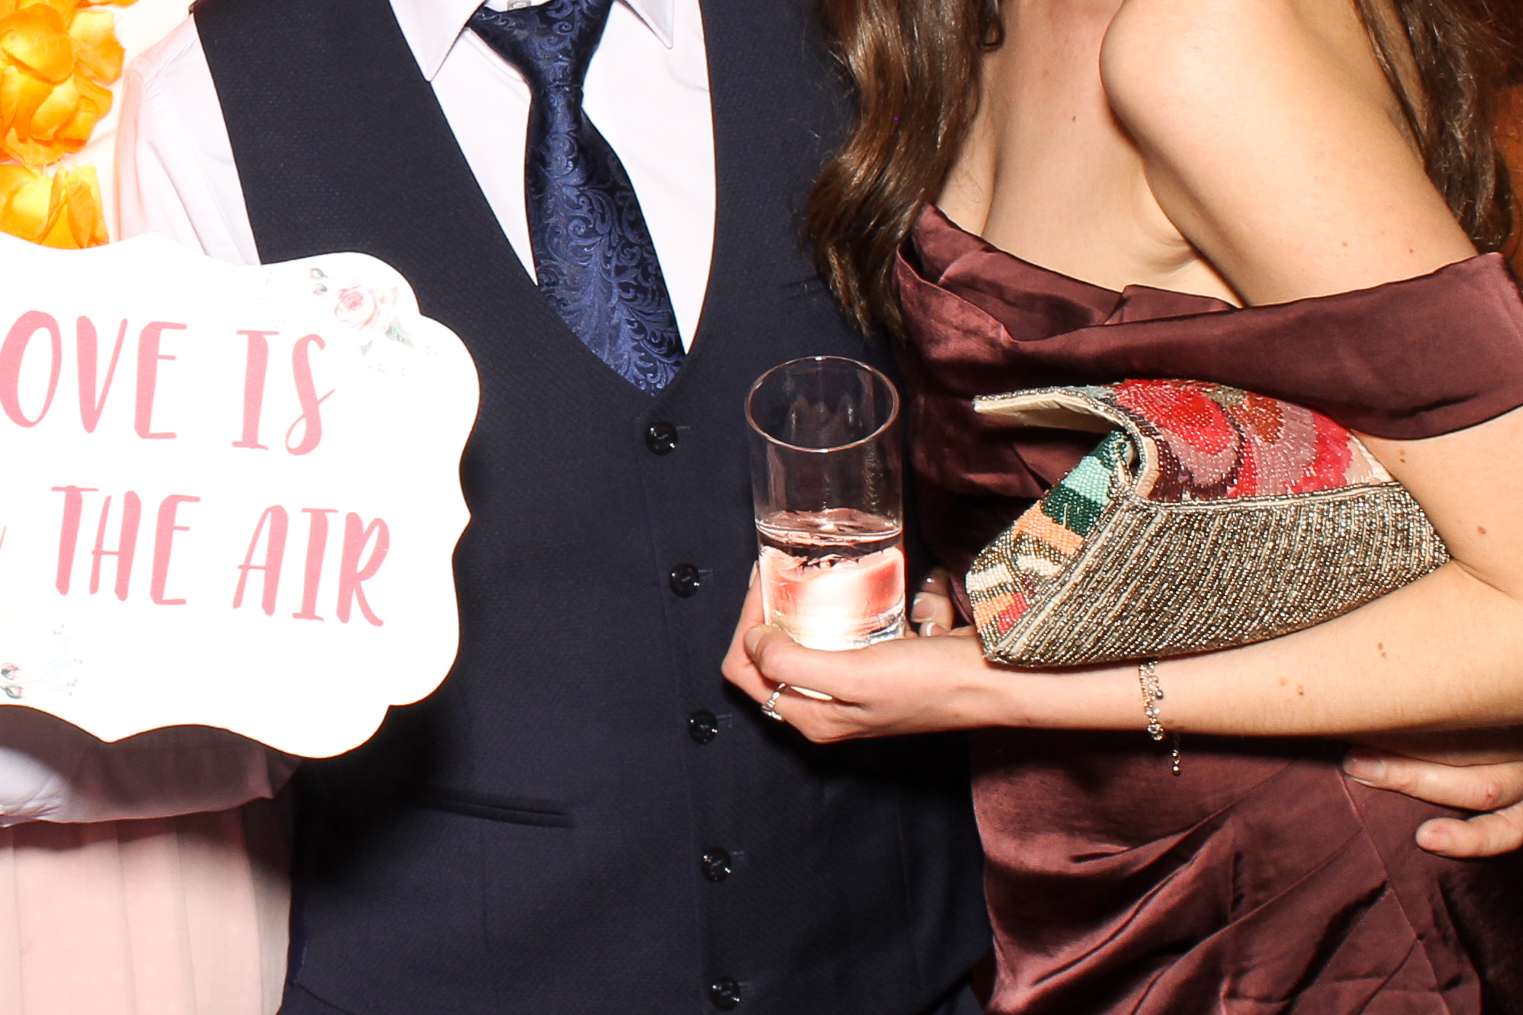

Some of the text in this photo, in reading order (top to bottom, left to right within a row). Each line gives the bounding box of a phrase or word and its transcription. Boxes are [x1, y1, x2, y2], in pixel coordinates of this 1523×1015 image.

[232, 329, 336, 456] IS
[51, 484, 201, 606] THE
[232, 504, 390, 627] AIR
